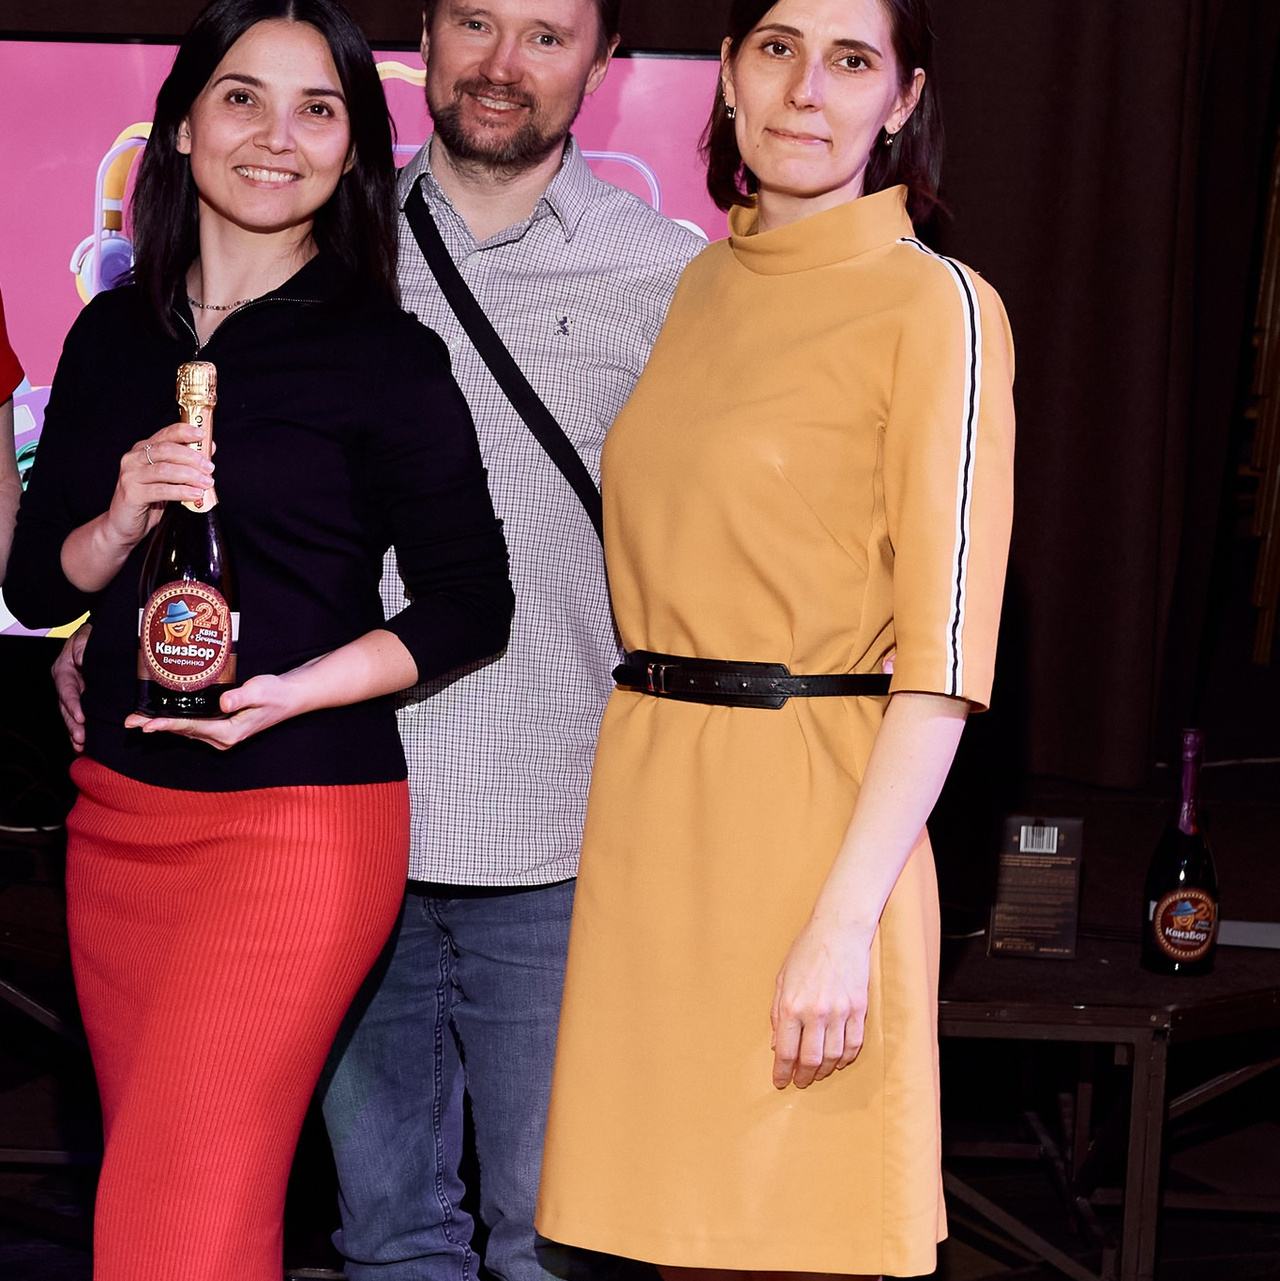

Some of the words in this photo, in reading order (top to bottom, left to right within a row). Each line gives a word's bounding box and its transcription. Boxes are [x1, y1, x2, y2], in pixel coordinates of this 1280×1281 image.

[194, 602, 214, 629] 2
[155, 642, 215, 660] КвизБор
[163, 656, 205, 667] Вечеринка
[1165, 926, 1207, 942] КвизБор
